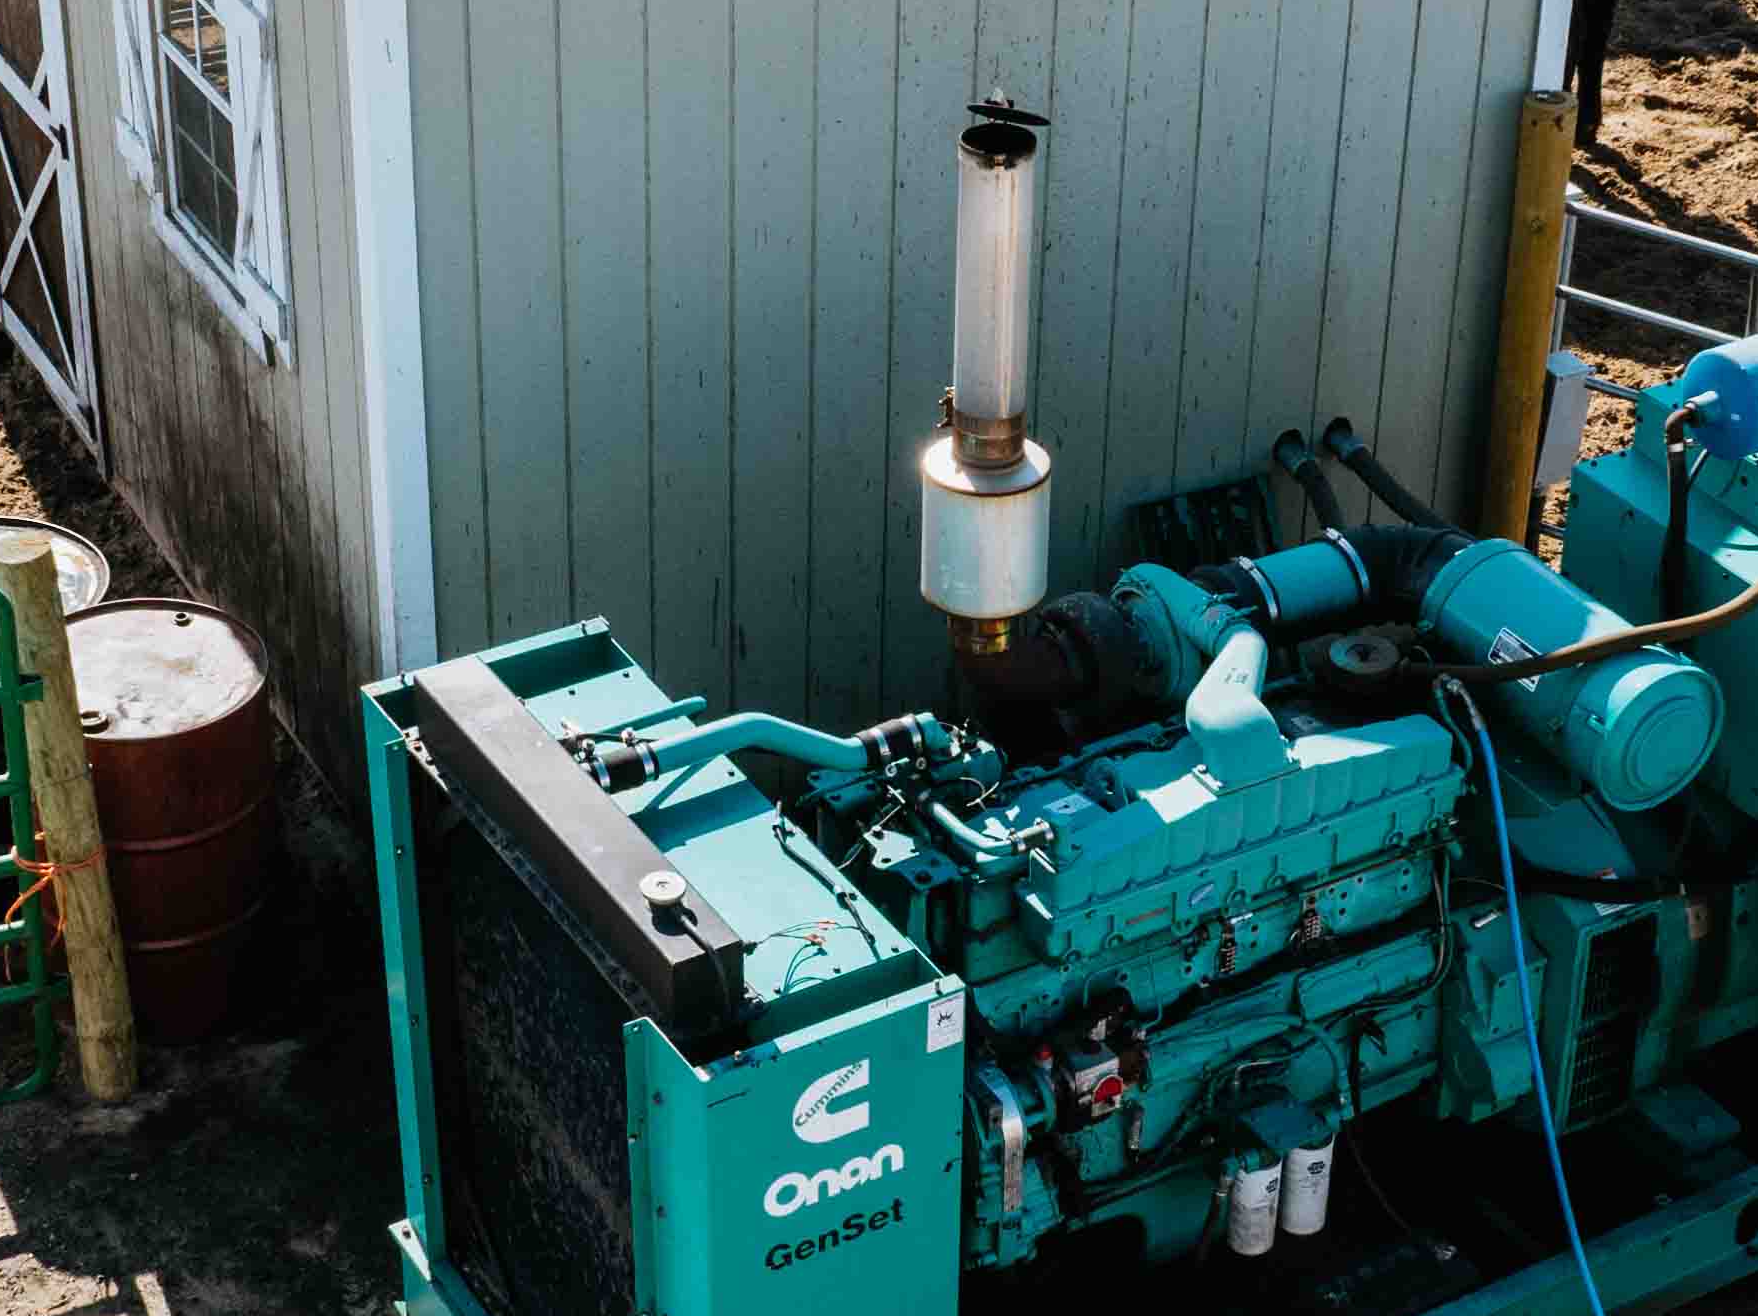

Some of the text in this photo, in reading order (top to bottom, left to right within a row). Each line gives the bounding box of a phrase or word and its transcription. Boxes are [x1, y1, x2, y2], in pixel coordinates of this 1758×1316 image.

[795, 1063, 862, 1126] Cummins
[763, 1144, 904, 1217] Onan
[765, 1198, 904, 1270] GenSet
